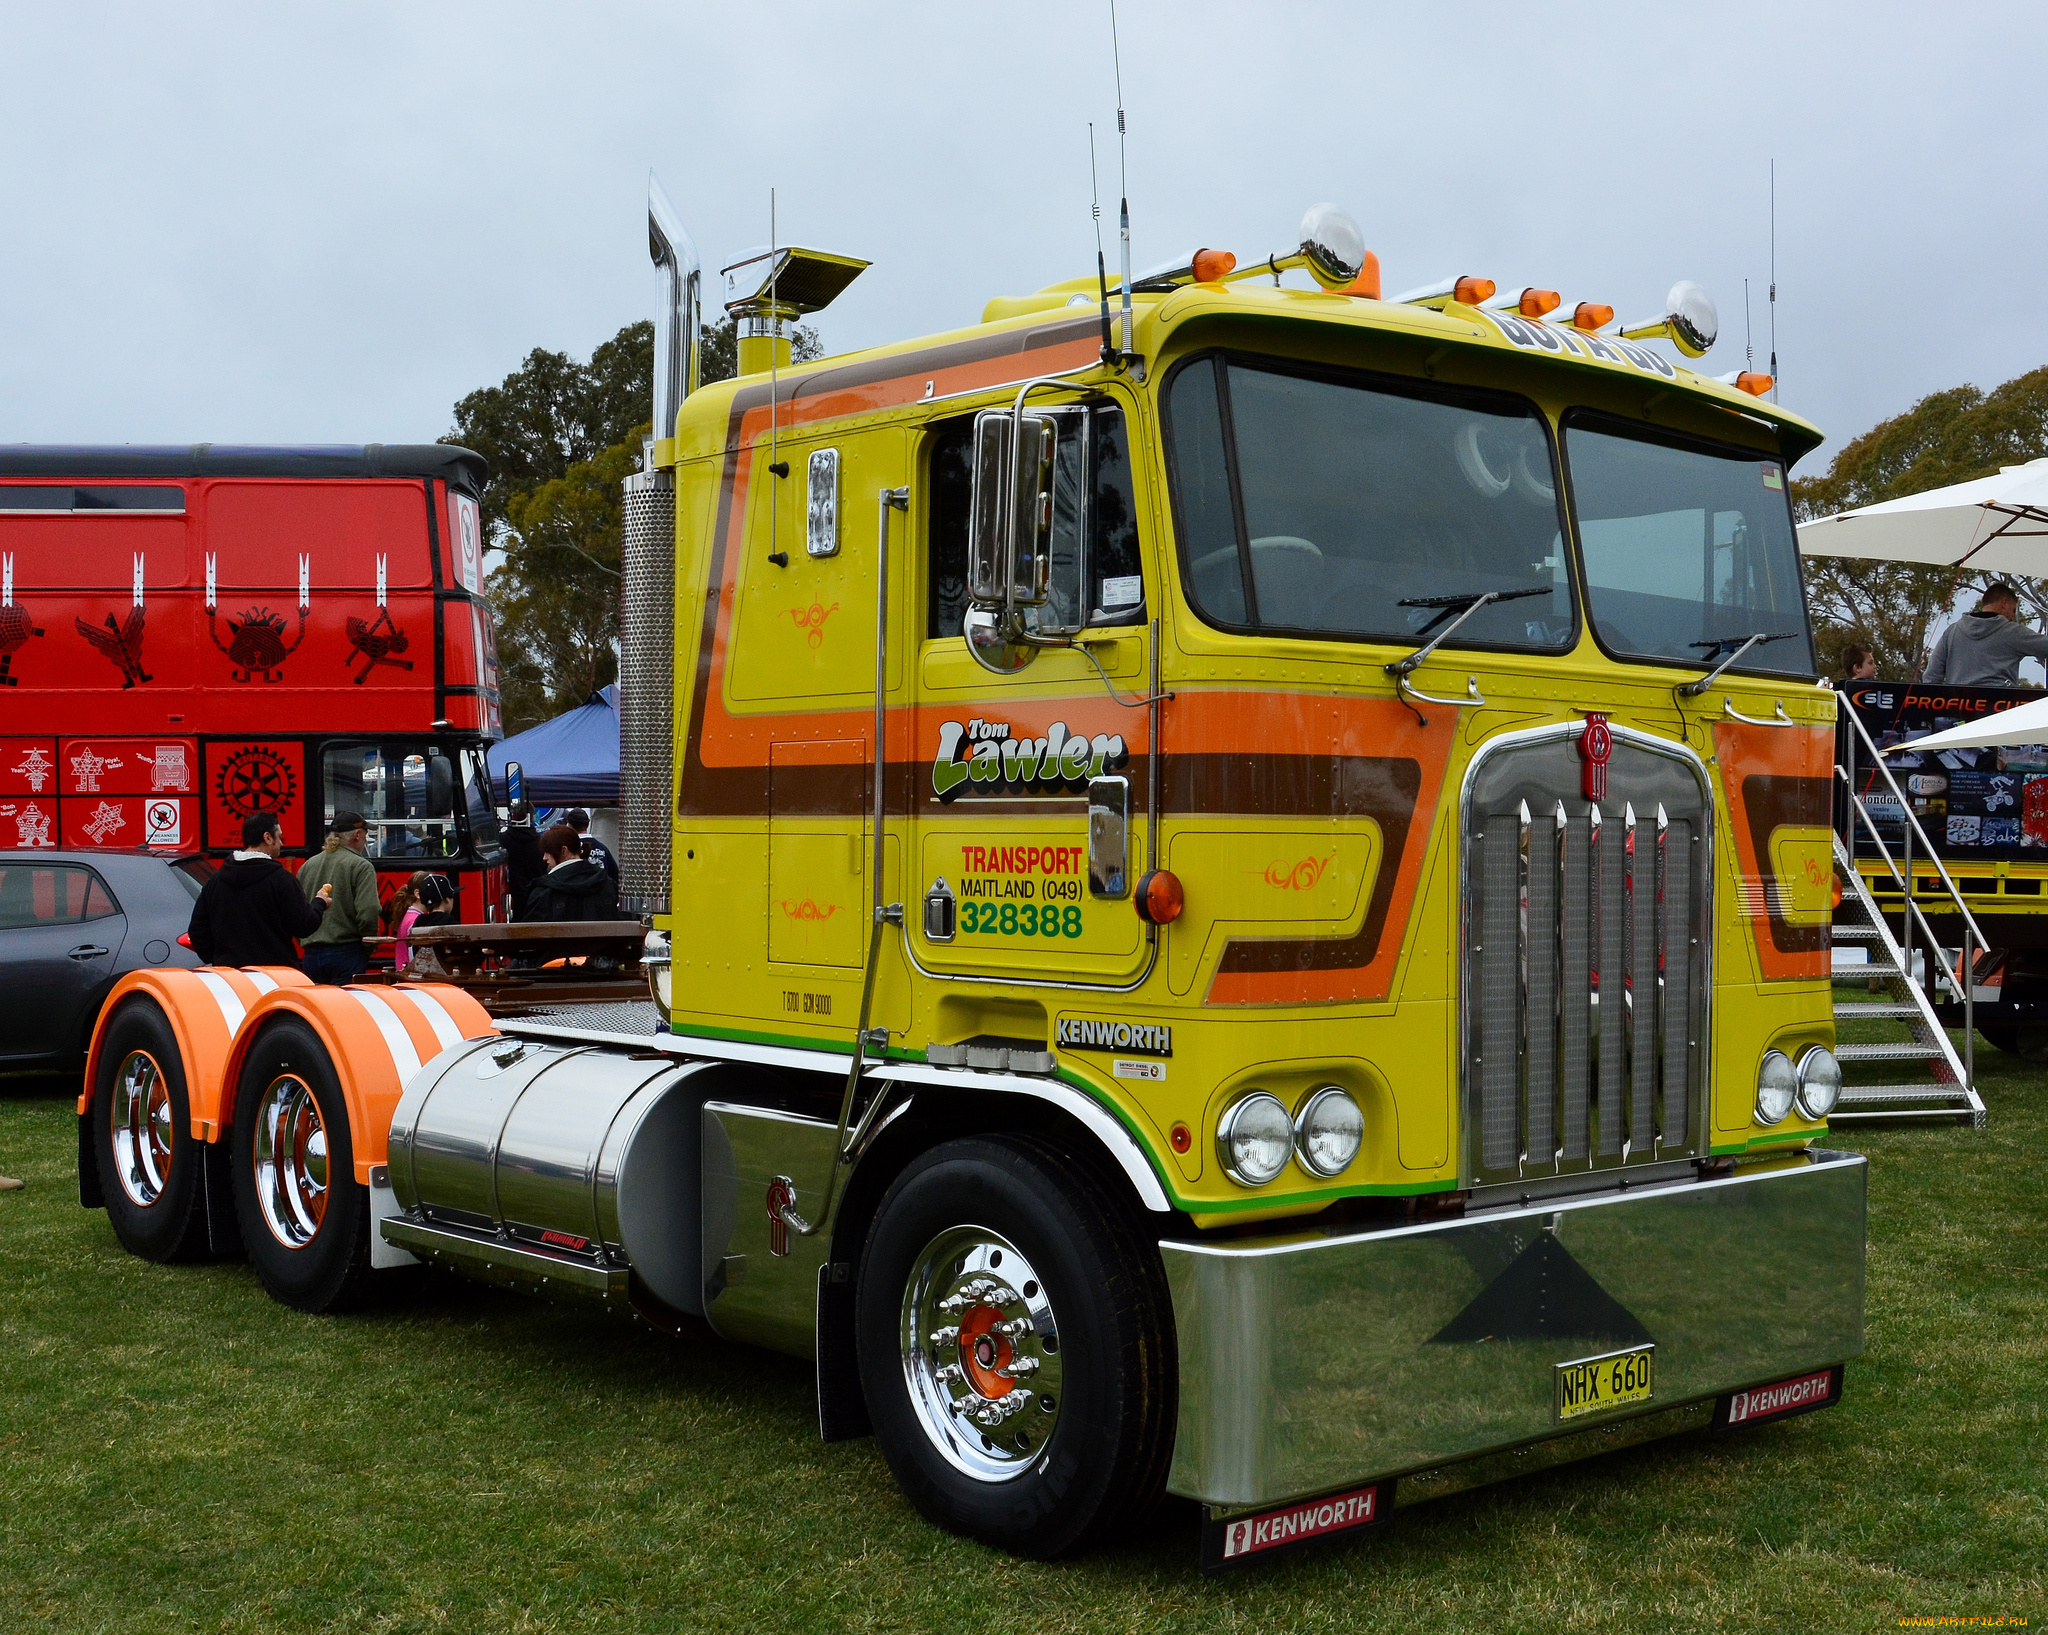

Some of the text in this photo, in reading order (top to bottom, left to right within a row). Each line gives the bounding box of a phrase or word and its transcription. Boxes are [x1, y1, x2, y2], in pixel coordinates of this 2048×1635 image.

[1903, 695, 1987, 712] PROFILE
[969, 718, 1009, 739] Tom
[932, 721, 1127, 800] Lawler
[961, 846, 1083, 875] TRANSPORT
[960, 879, 1083, 902] MAITLAND (049)
[960, 902, 1083, 938] 328388
[1057, 1019, 1171, 1051] KENWORTH
[1590, 1398, 1613, 1410] SOUTH
[1617, 1392, 1640, 1403] WALES
[1750, 1376, 1828, 1413] KENWORTH
[1254, 1493, 1372, 1545] KENWORTH
